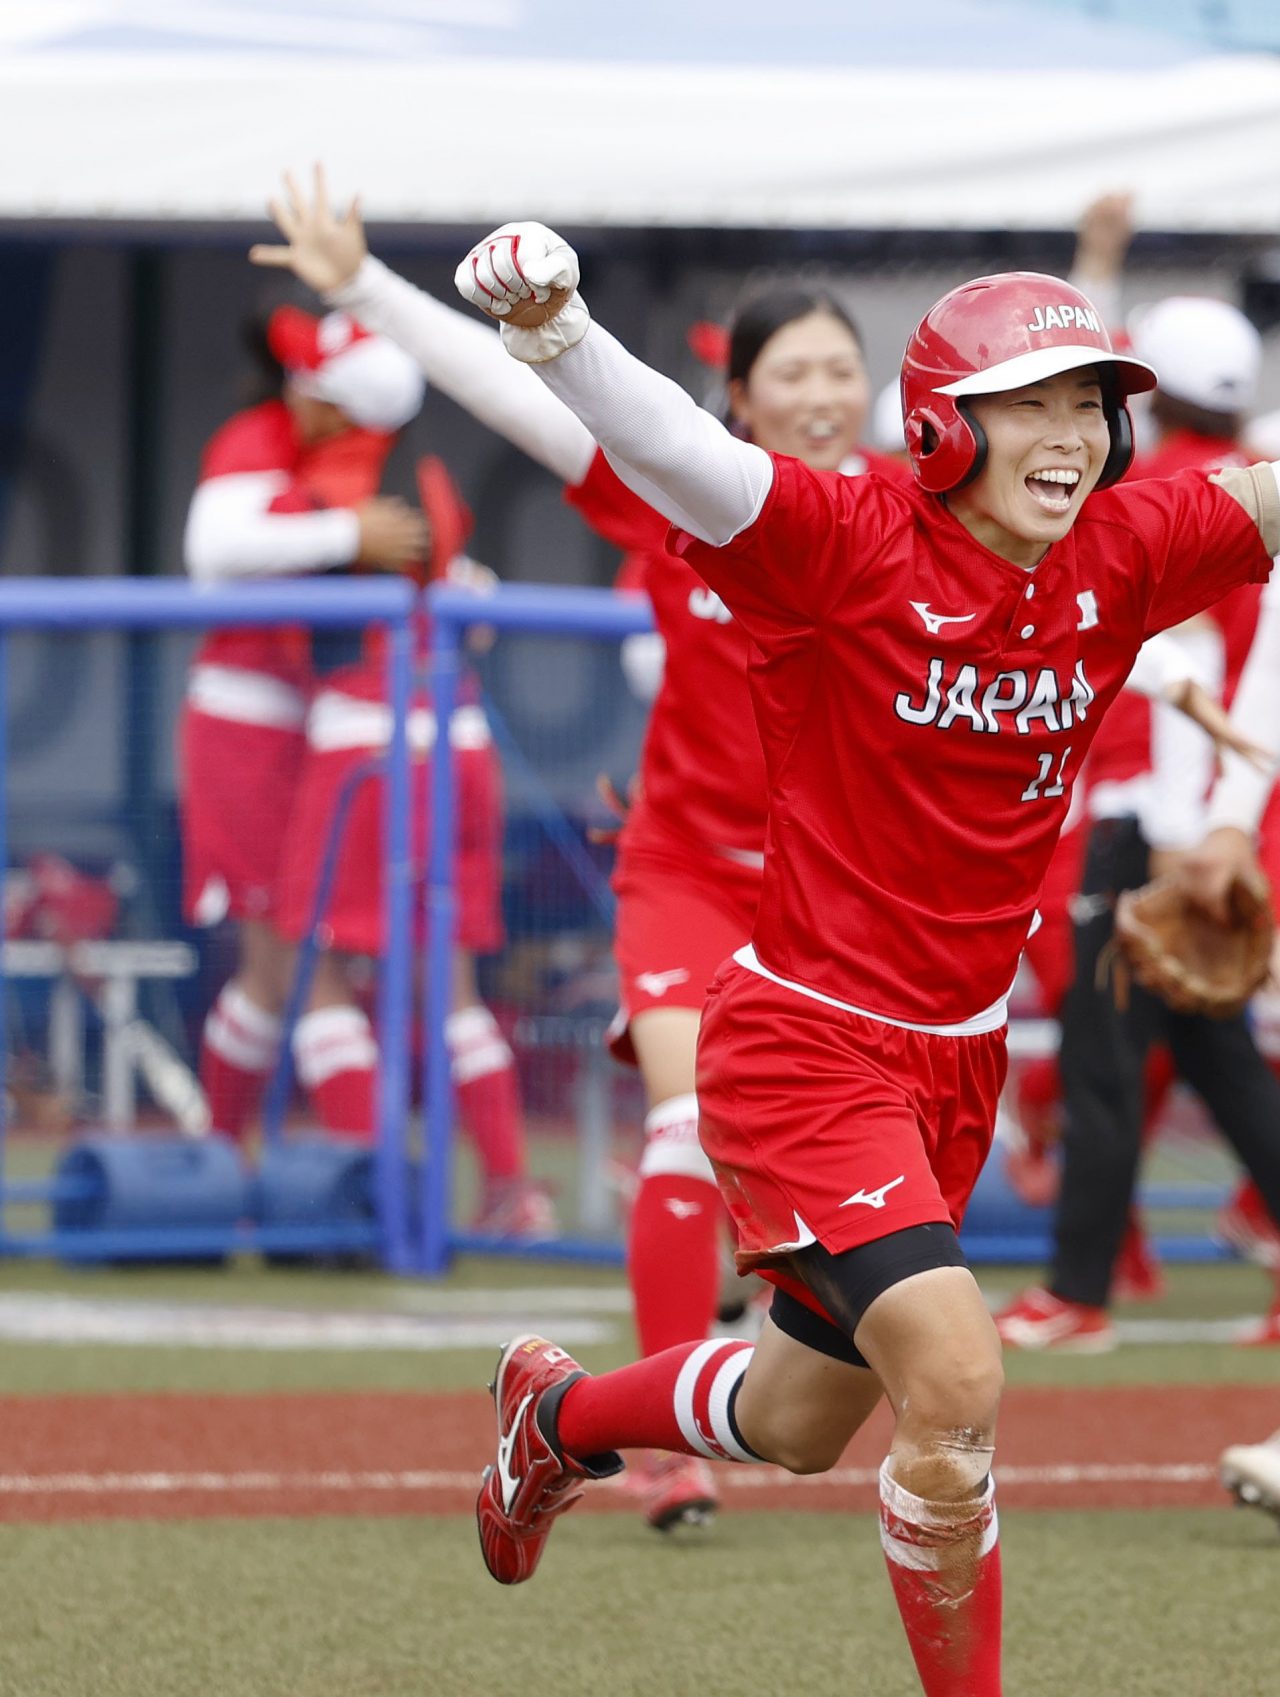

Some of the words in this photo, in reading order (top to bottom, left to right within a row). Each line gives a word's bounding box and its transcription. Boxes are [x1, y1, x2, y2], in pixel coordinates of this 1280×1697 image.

[1028, 304, 1100, 333] JAPAN
[894, 656, 1096, 735] JAPAN
[1019, 745, 1073, 802] 11
